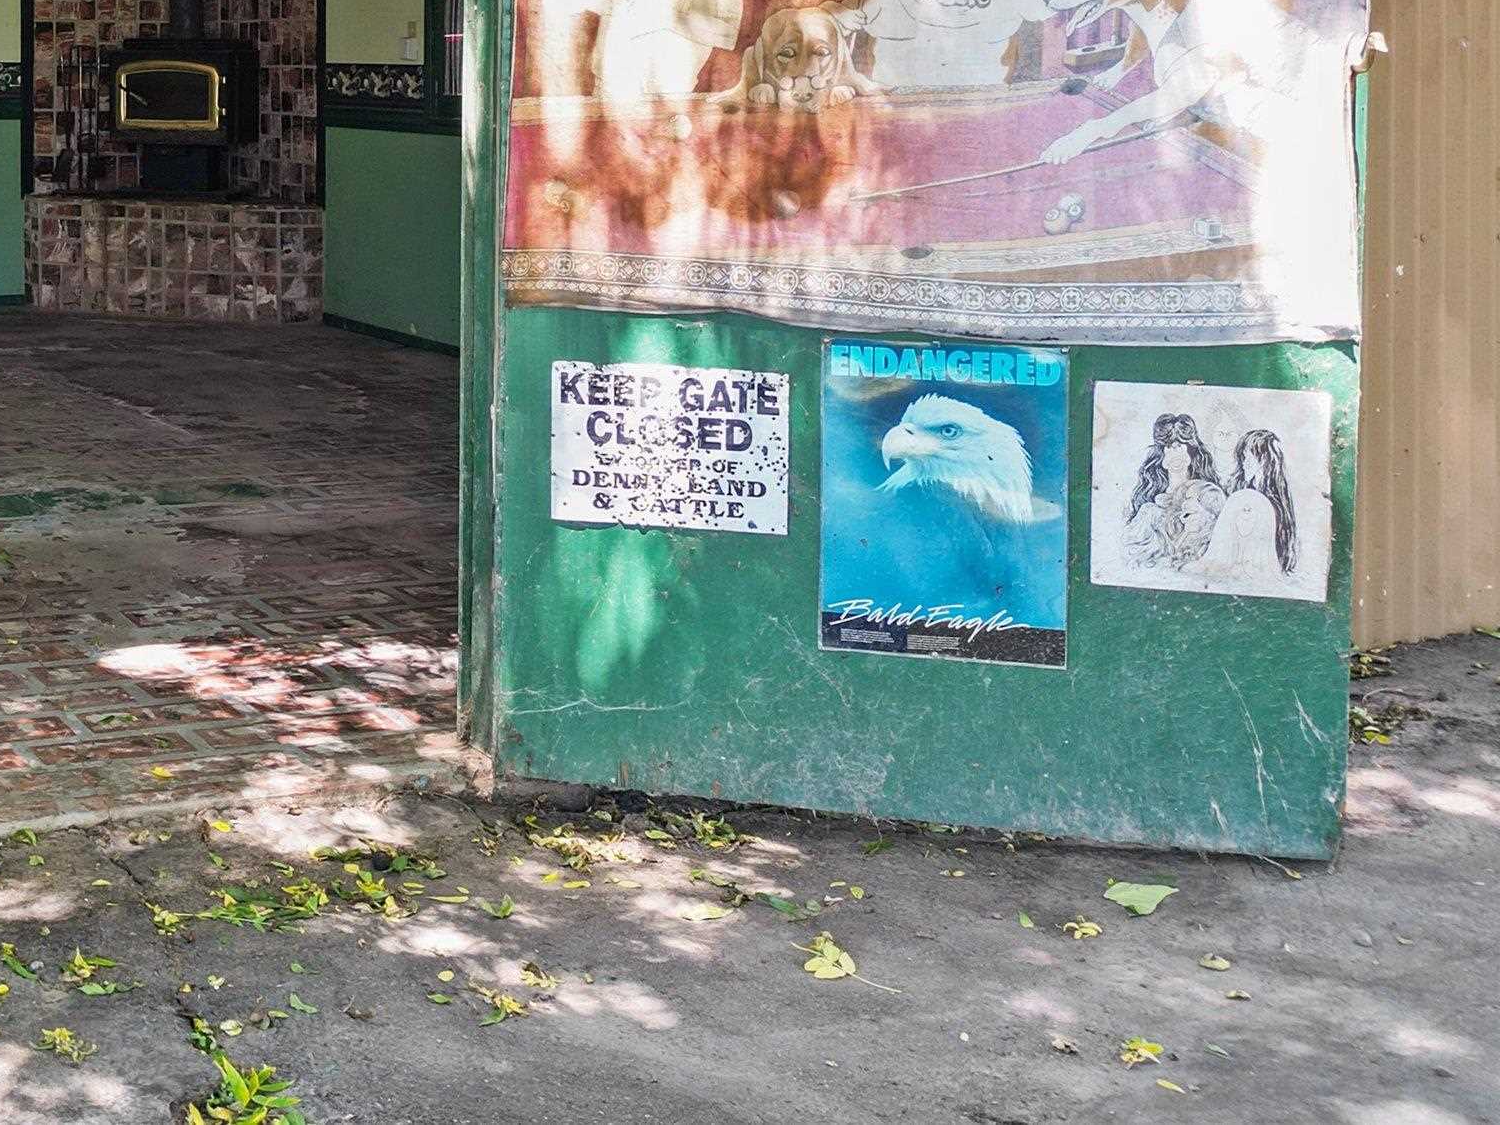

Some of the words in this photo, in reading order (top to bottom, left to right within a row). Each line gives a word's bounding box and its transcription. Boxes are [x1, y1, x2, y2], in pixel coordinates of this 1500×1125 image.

[830, 345, 1061, 386] ENDANGERED
[560, 372, 661, 408] KEEP
[678, 377, 780, 416] GATE
[586, 410, 753, 452] CLOSED
[687, 476, 767, 498] LAND
[712, 459, 739, 474] OF
[593, 492, 614, 510] &
[631, 493, 745, 519] CATTLE
[828, 599, 925, 626] Bald
[924, 604, 1031, 643] Eagle
